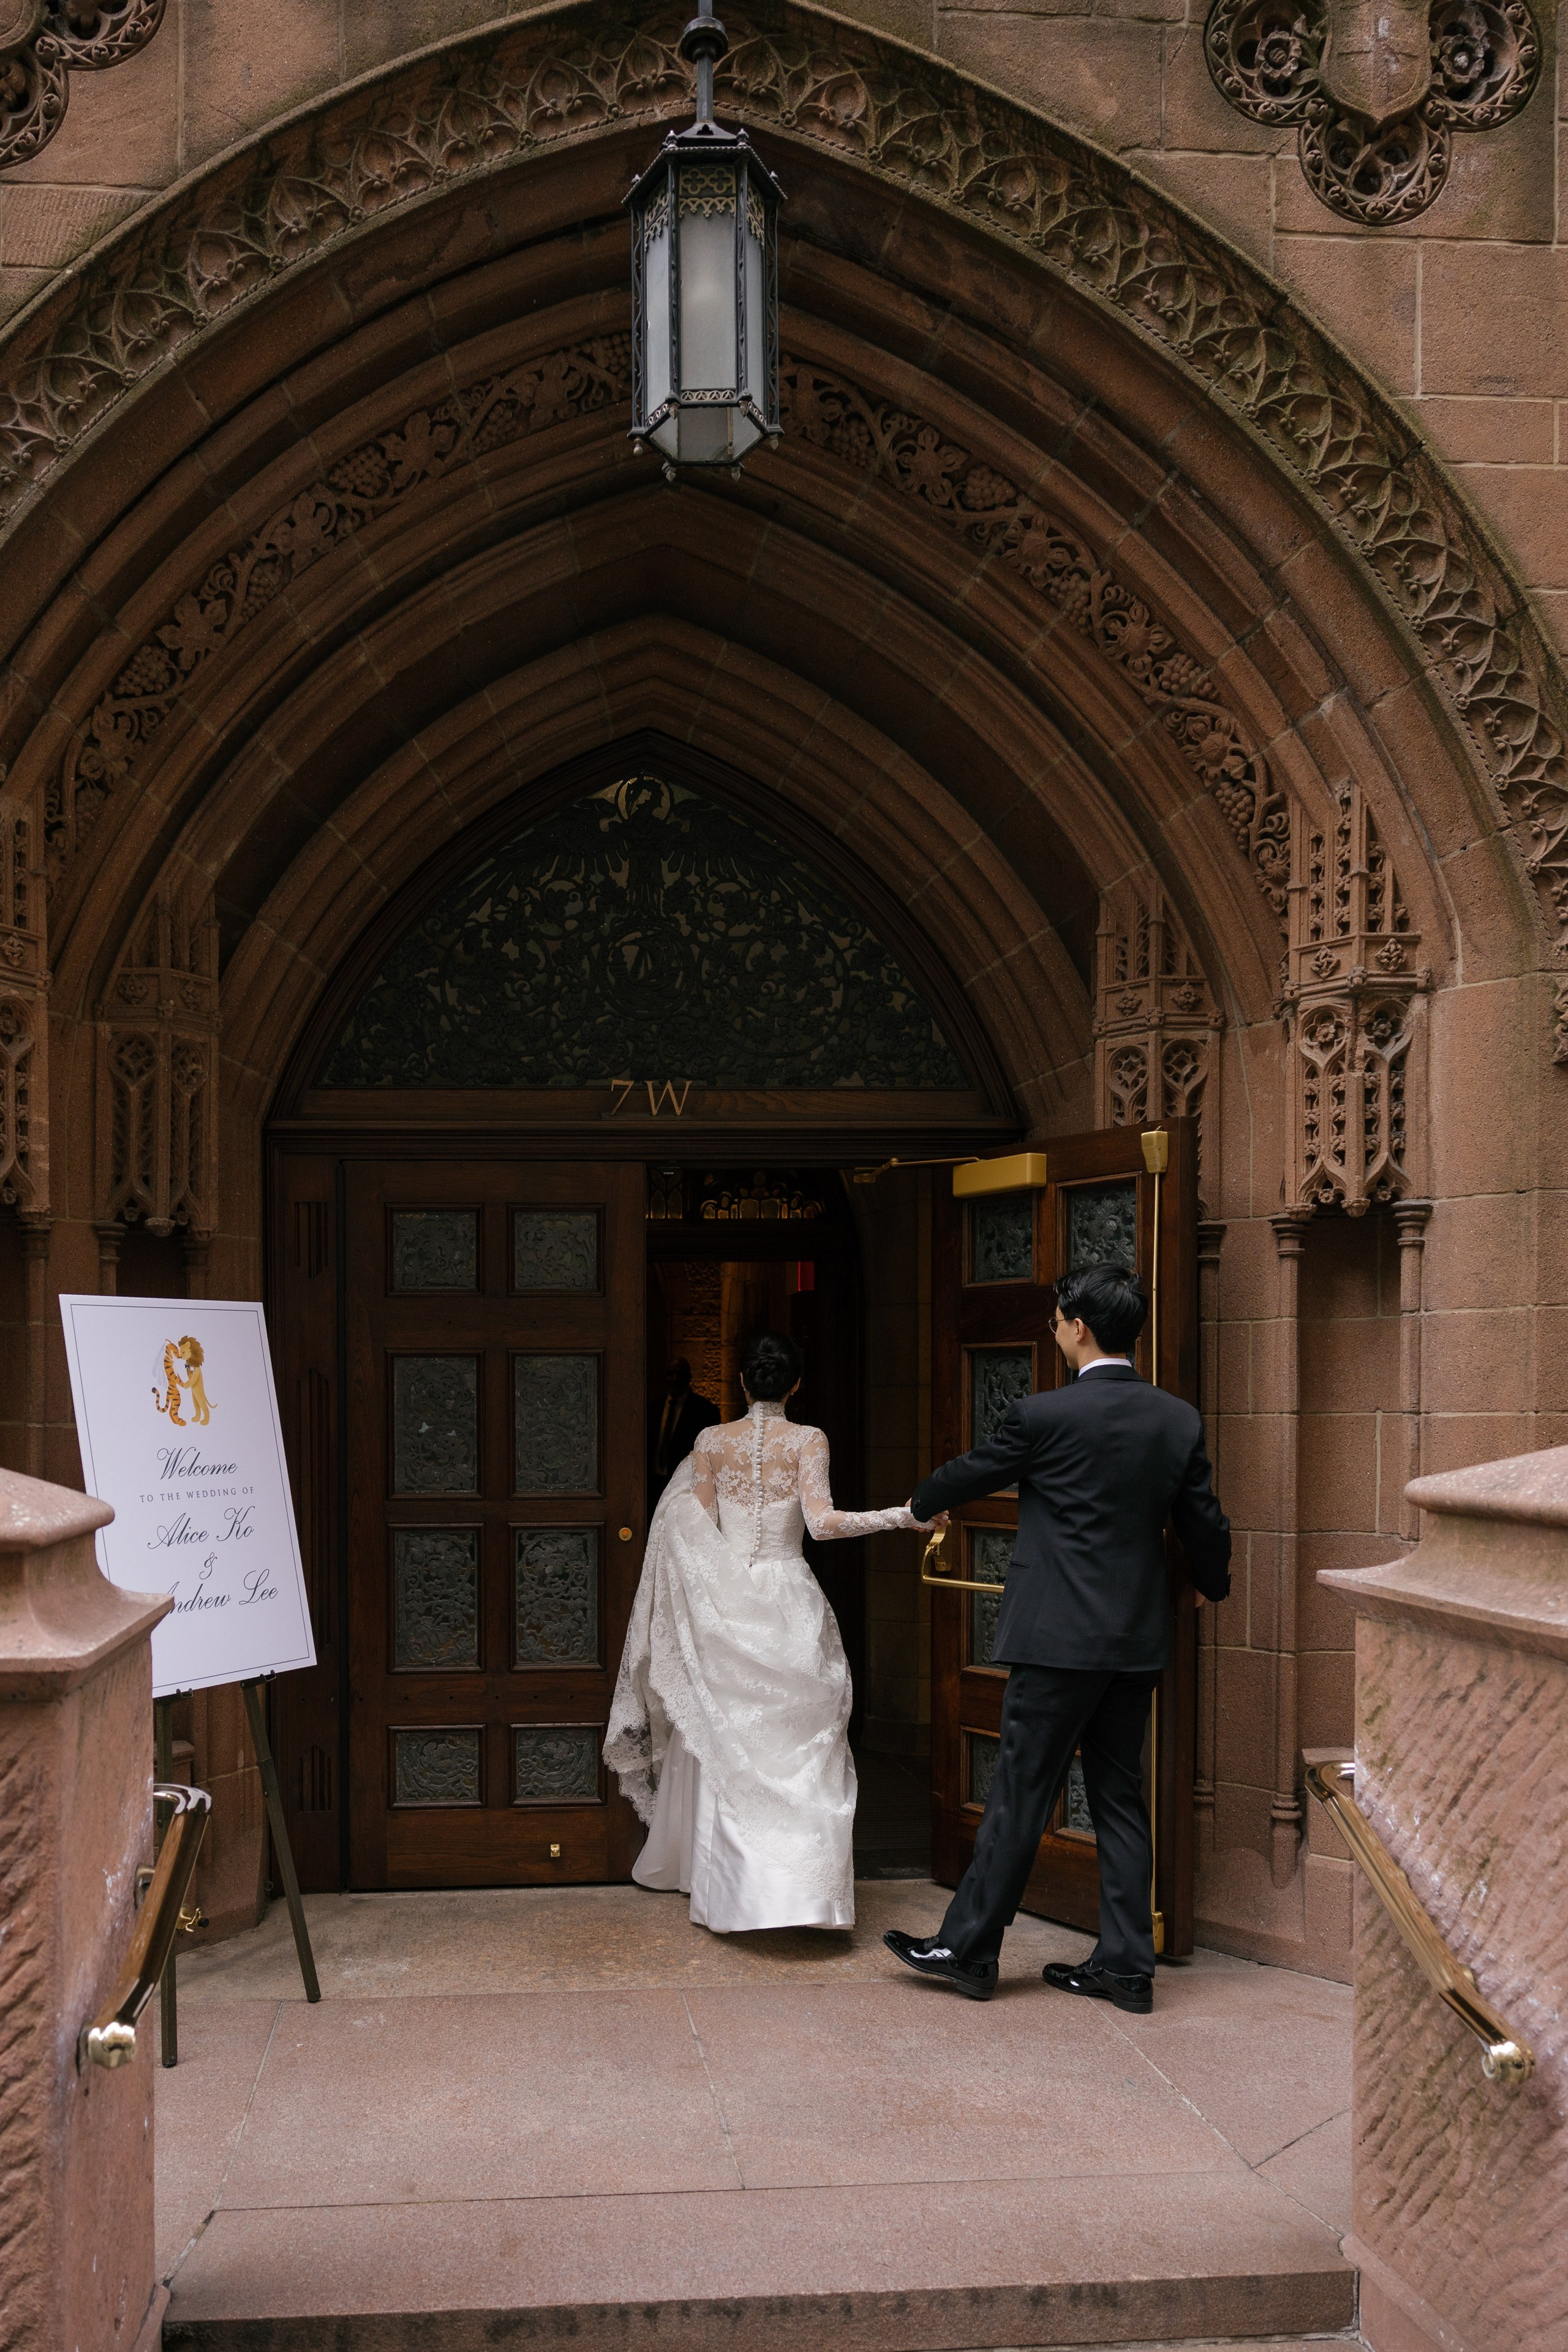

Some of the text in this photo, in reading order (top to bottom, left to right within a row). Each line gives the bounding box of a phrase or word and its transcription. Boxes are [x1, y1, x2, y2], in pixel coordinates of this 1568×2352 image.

[156, 1446, 238, 1480] Welcome
[139, 1486, 254, 1502] TO THE WEDDING OF
[147, 1506, 255, 1549] Alice Ko
[198, 1552, 218, 1580] &
[238, 1569, 279, 1605] Lee
